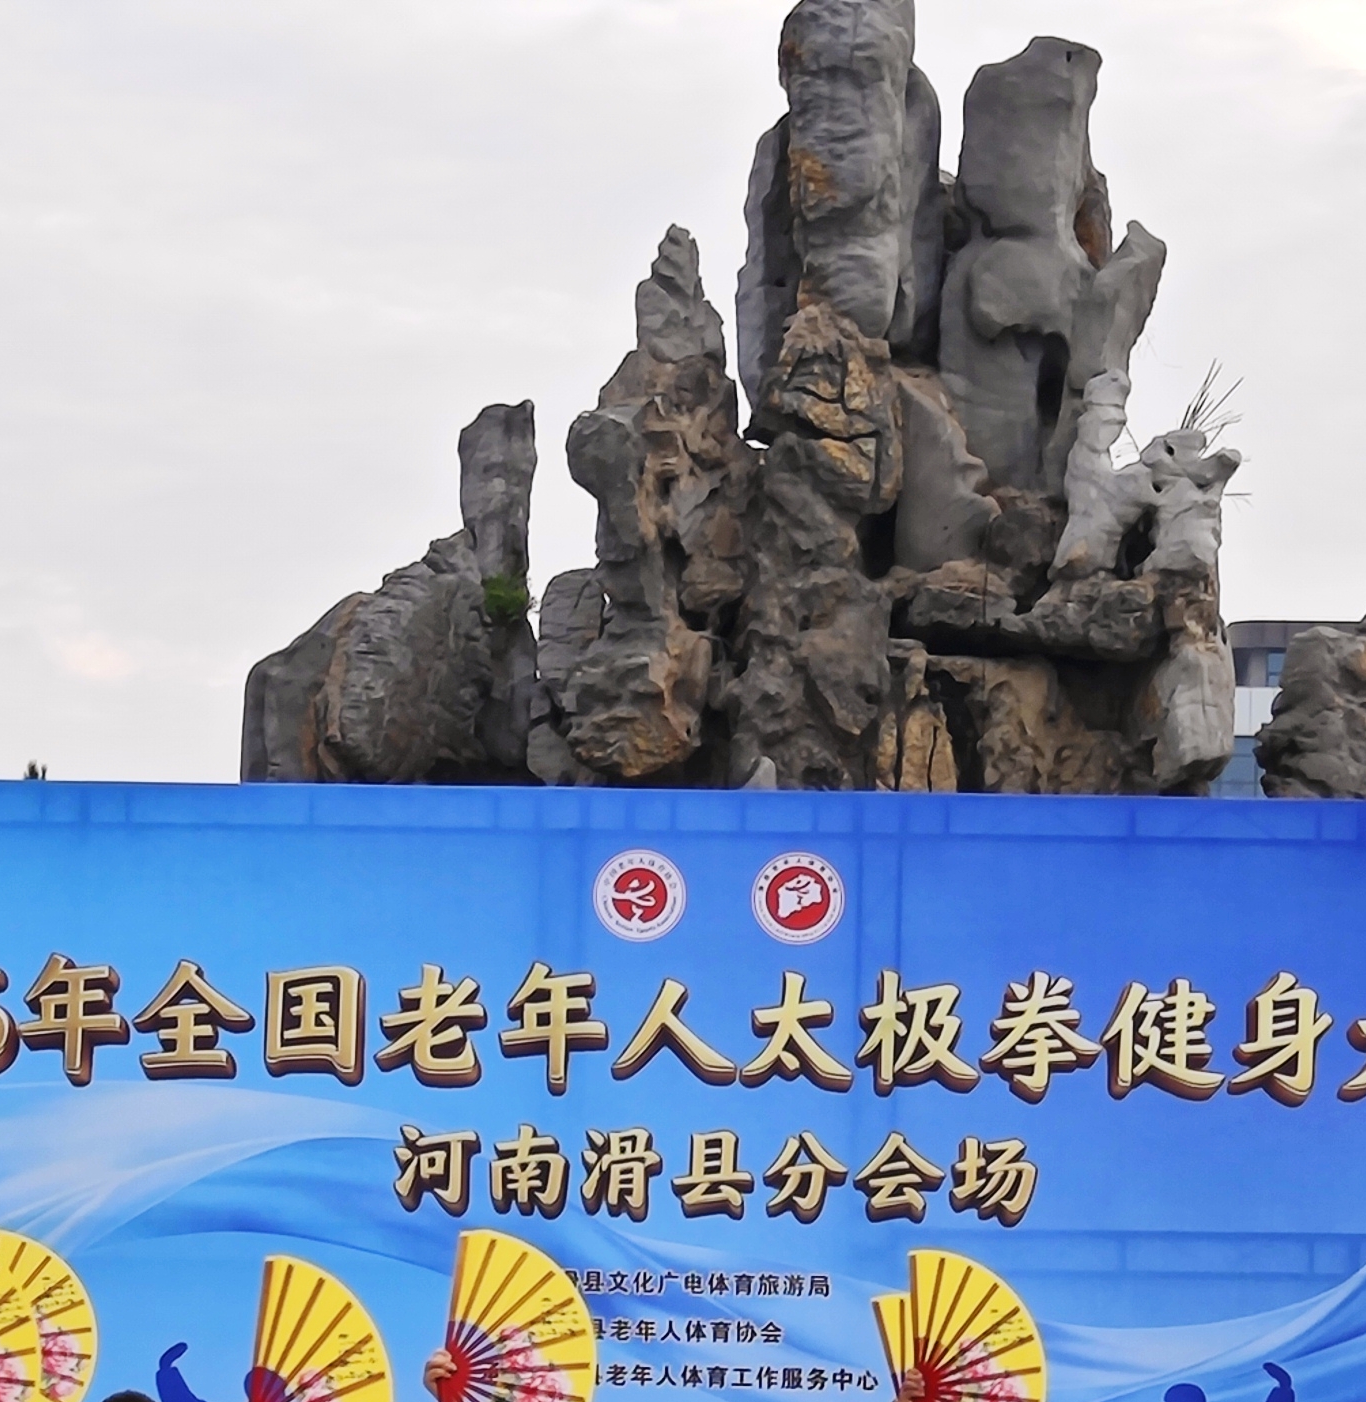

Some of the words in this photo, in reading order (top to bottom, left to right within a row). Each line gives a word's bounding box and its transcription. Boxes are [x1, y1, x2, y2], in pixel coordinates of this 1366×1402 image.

[393, 1123, 1039, 1226] 河南滑县分会场
[596, 1364, 878, 1391] 老年人体育工作服务中心
